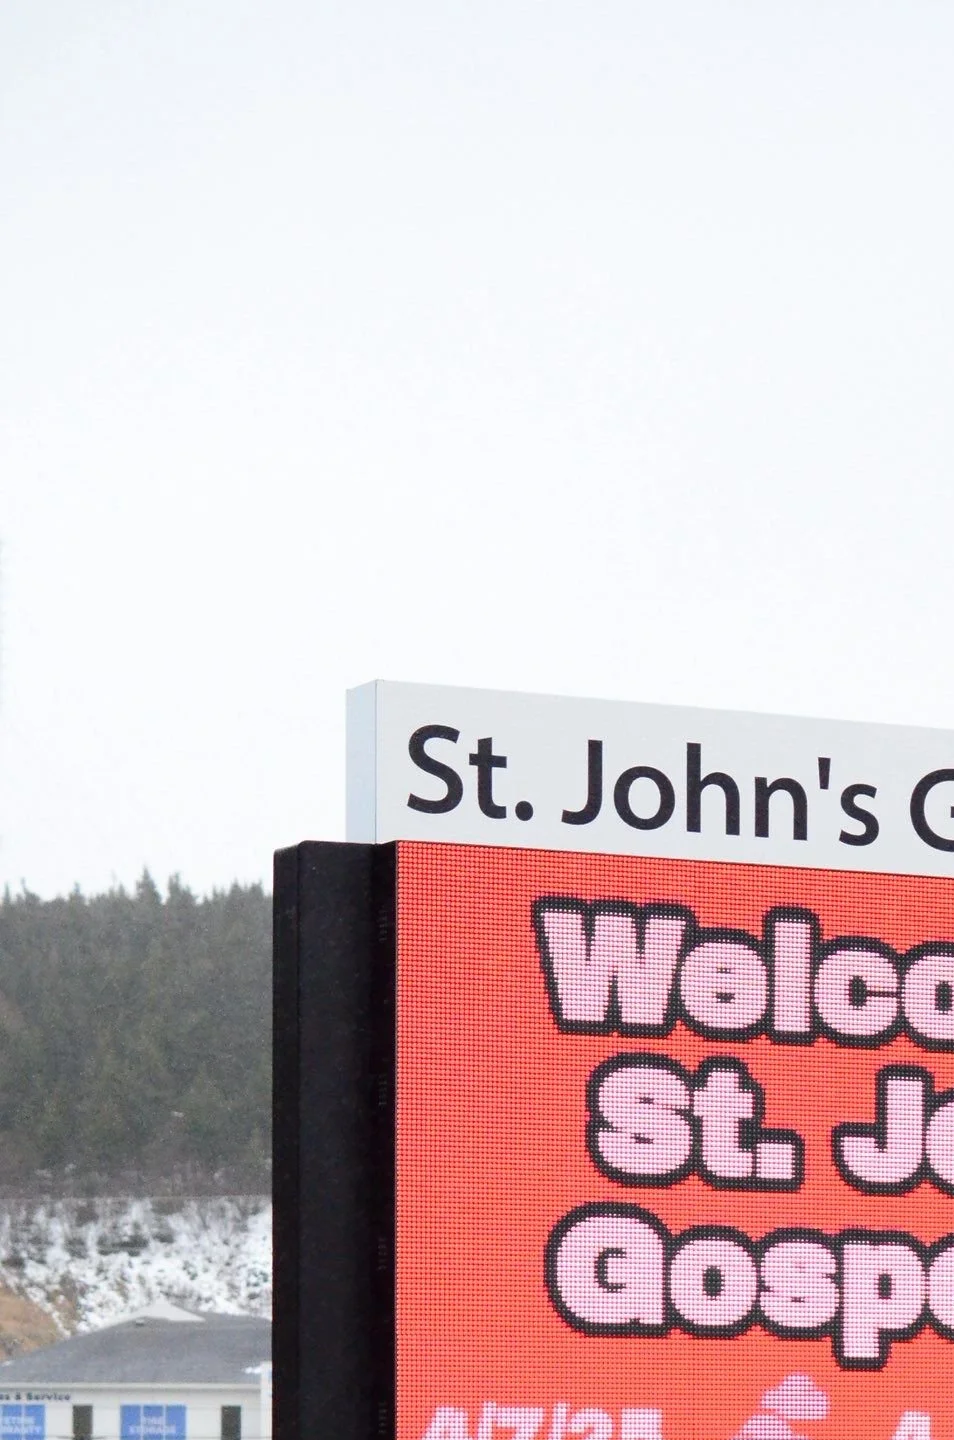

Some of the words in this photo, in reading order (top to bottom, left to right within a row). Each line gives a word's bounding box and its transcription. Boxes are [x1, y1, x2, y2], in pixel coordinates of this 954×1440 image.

[408, 724, 534, 822] St.
[562, 740, 880, 847] John's
[588, 1054, 803, 1191] St.
